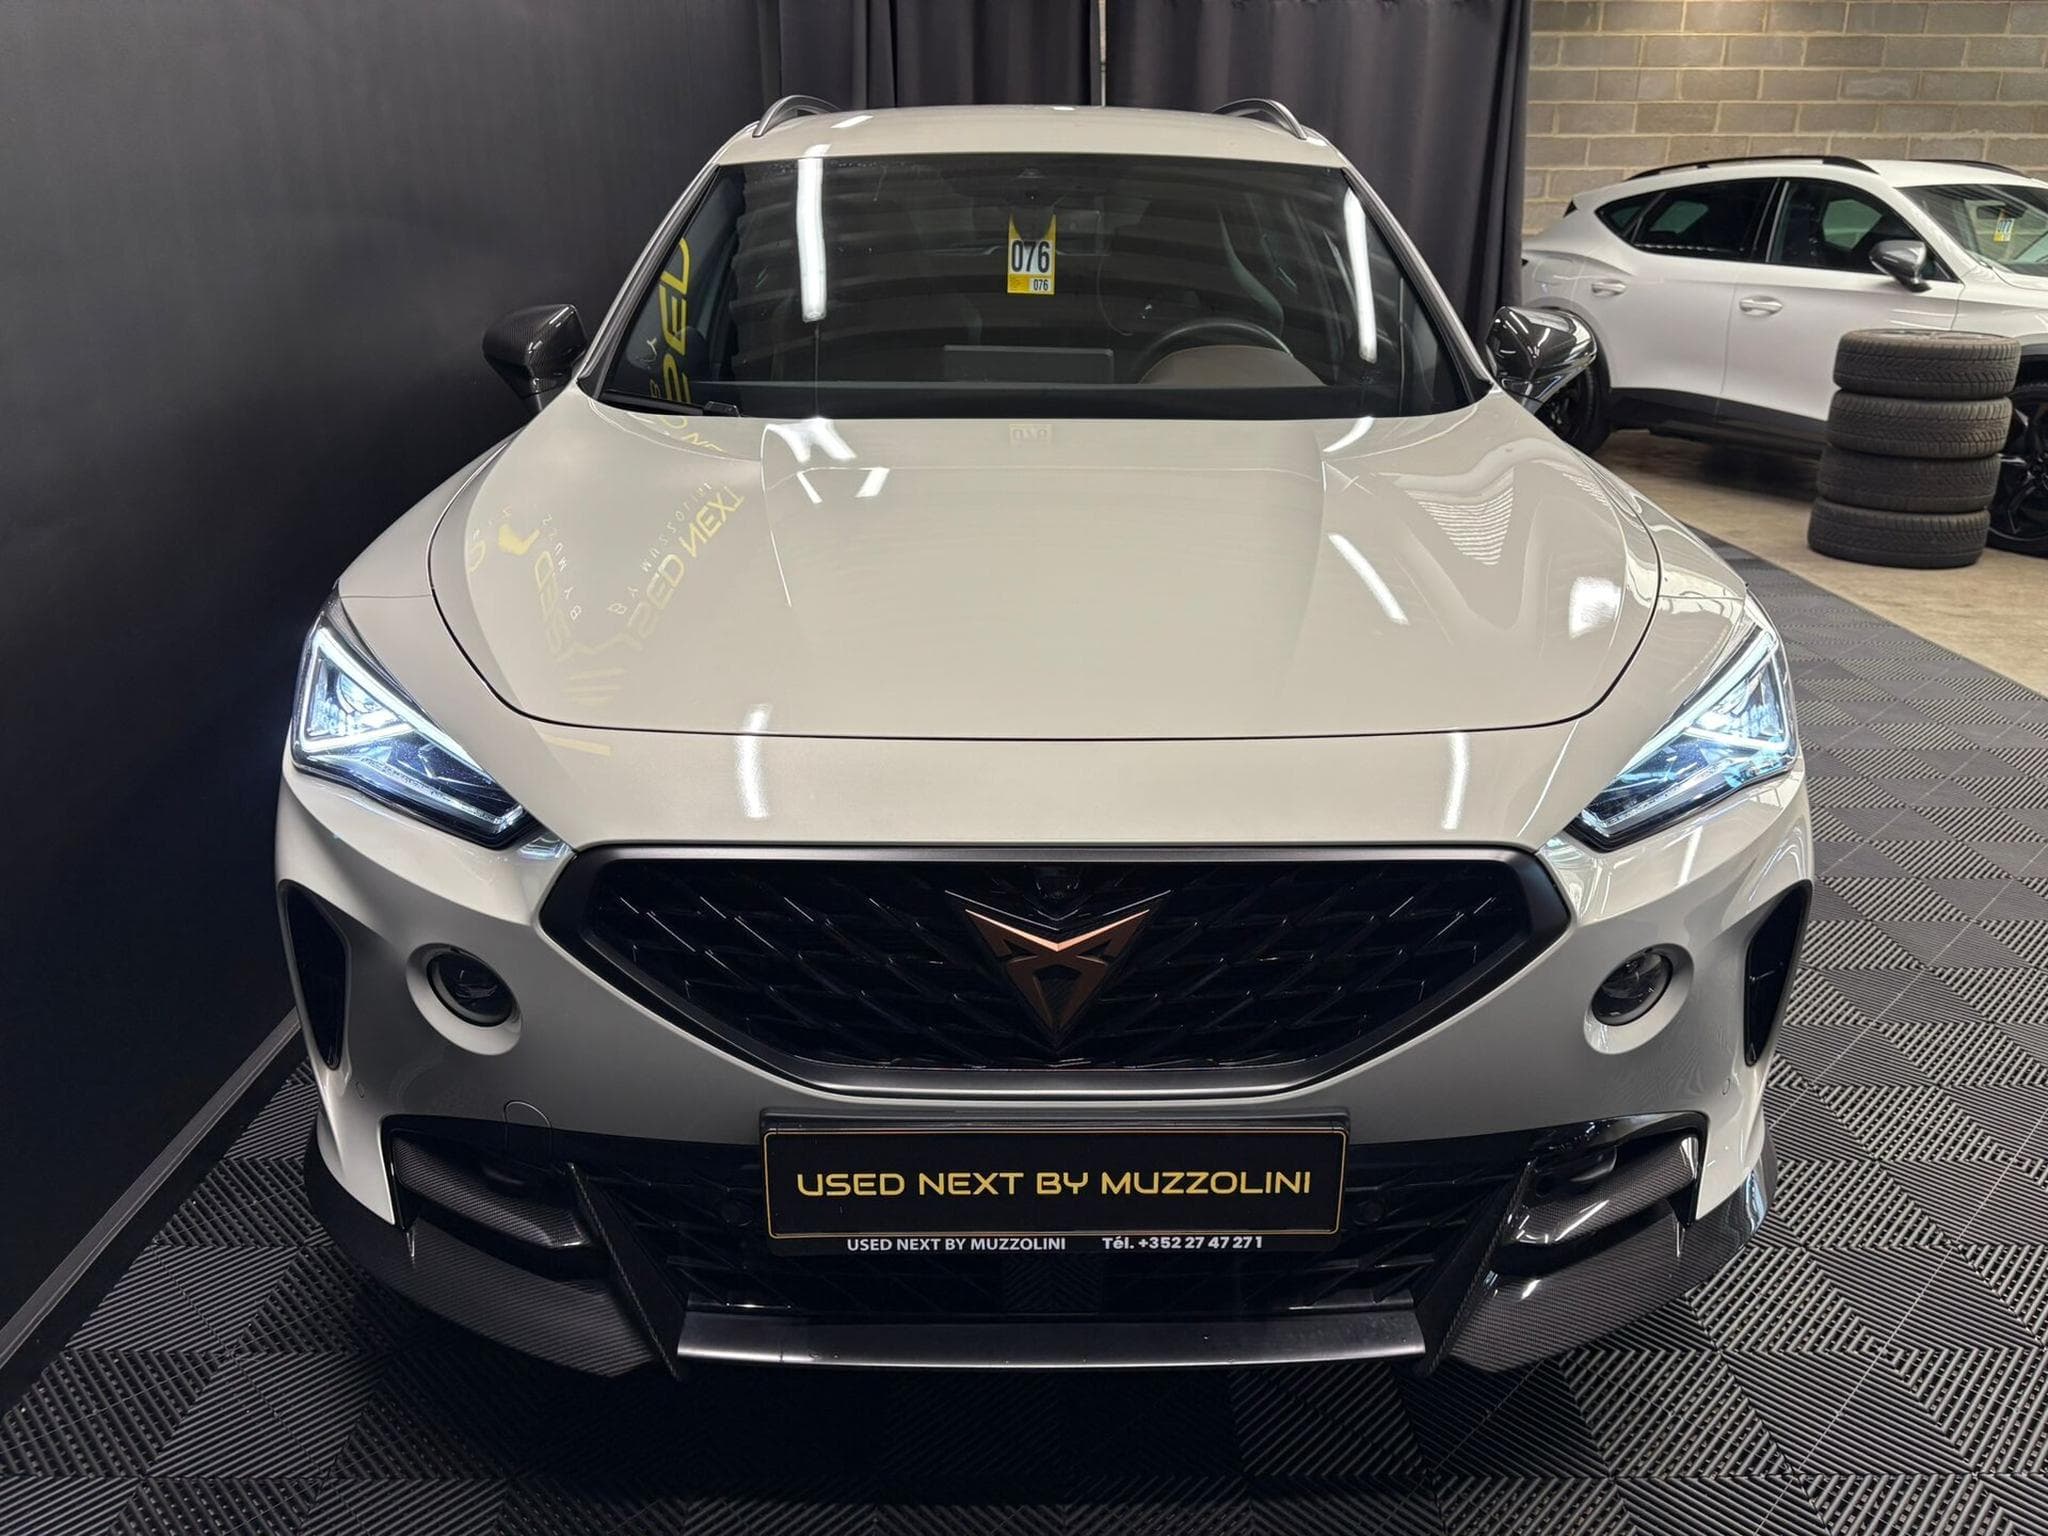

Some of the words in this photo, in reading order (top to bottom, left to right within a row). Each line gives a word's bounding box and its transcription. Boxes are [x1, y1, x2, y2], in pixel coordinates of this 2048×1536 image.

[1011, 240, 1050, 273] 076
[1033, 279, 1049, 291] 076
[797, 1172, 906, 1196] USED
[918, 1172, 1025, 1196] NEXT
[1035, 1171, 1089, 1195] BY
[1101, 1170, 1311, 1195] MUZZOLINI
[847, 1238, 892, 1251] USED
[897, 1238, 941, 1251] NEXT
[945, 1238, 966, 1251] BY
[970, 1237, 1066, 1251] MUZZOLINI
[1102, 1235, 1135, 1250] Tél.
[1138, 1235, 1182, 1250] +352
[1184, 1235, 1205, 1249] 27
[1207, 1235, 1230, 1249] 47
